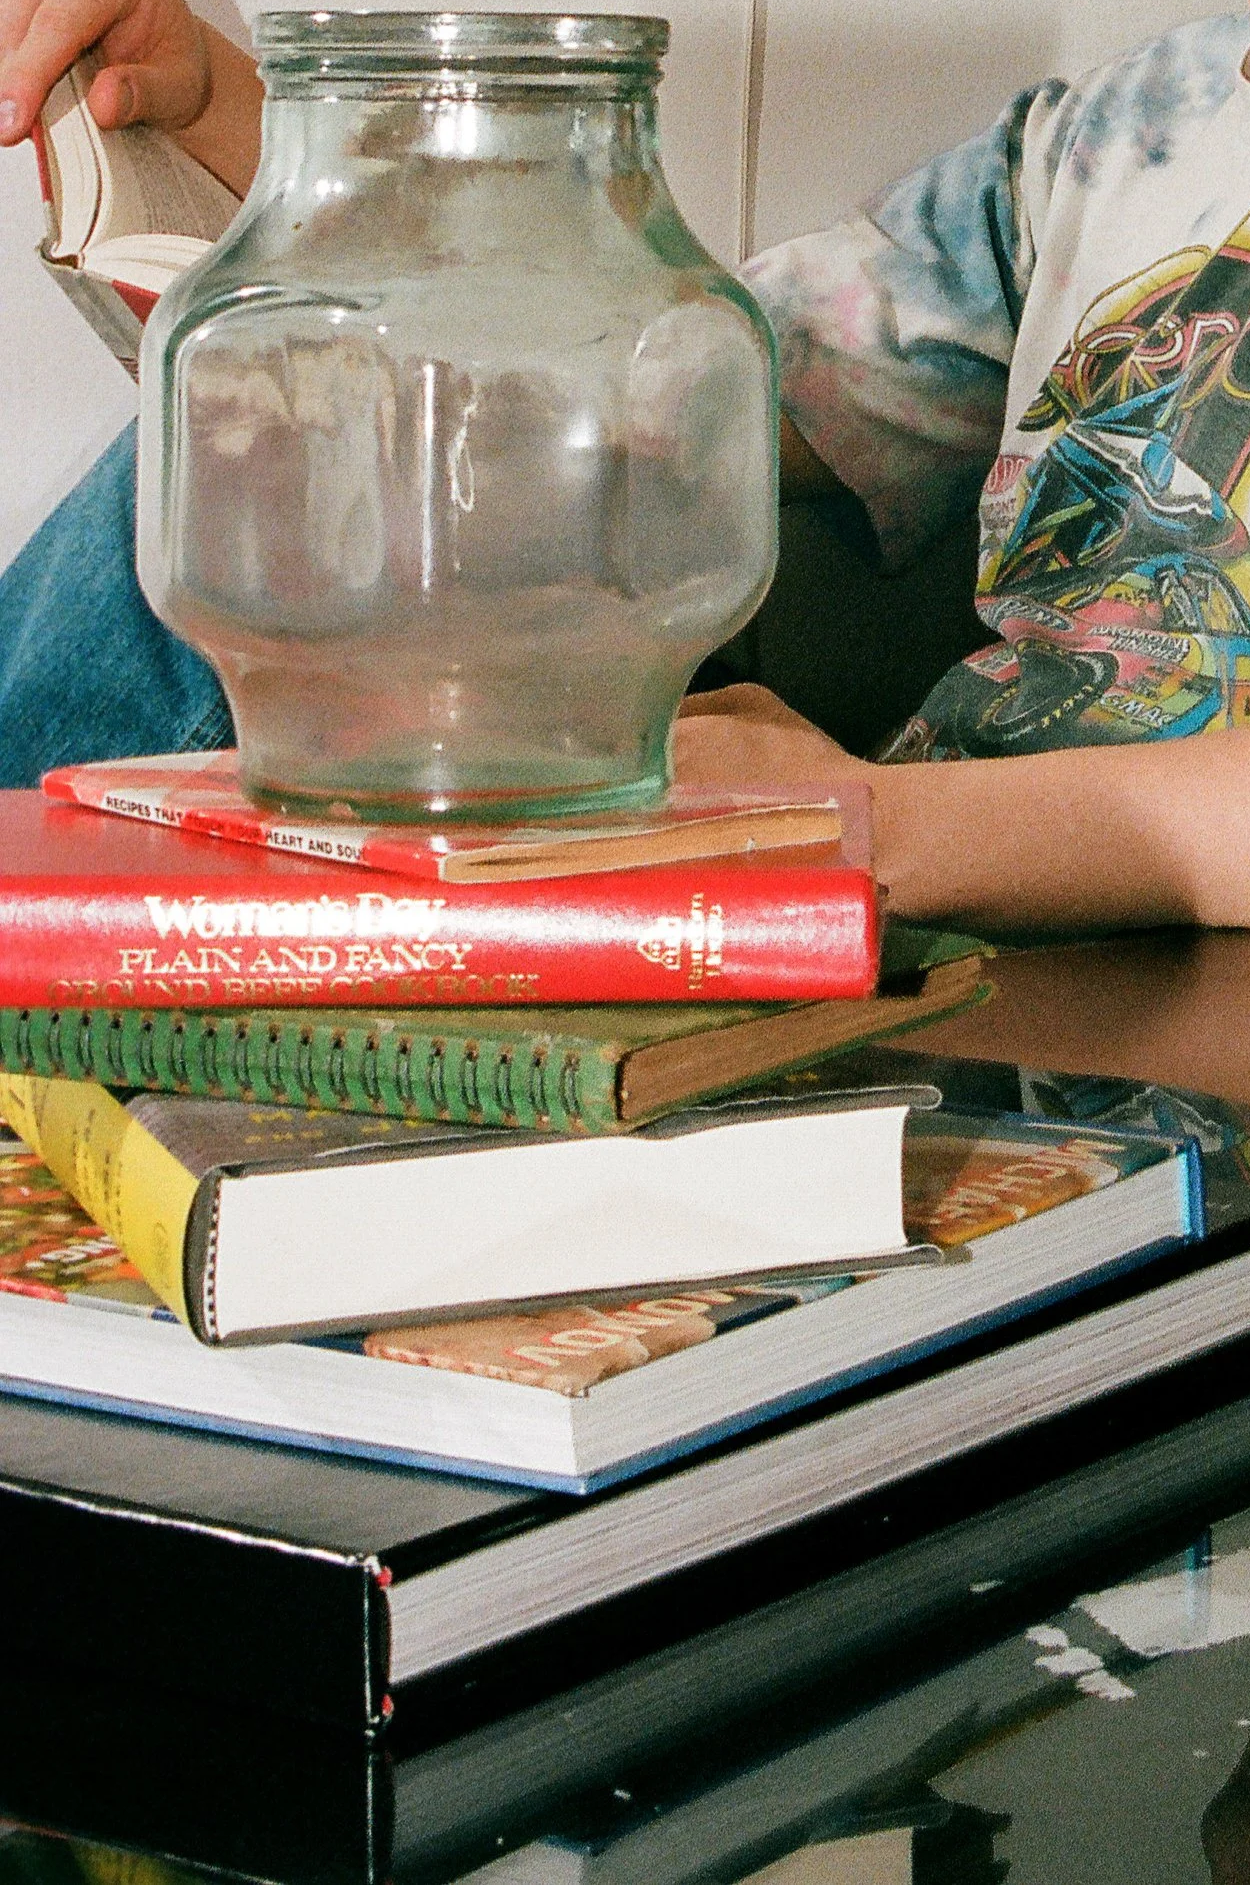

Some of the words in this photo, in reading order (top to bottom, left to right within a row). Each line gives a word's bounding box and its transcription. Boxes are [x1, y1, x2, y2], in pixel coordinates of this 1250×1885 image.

[1086, 625, 1191, 653] AUTOMOTIVE
[105, 795, 152, 818] RECIPES
[154, 806, 184, 824] THAT
[265, 830, 303, 849] HEART
[308, 839, 333, 855] AND
[144, 894, 350, 941] Woman's
[354, 892, 446, 941] Day
[118, 947, 242, 975] PLAIN
[248, 945, 338, 973] AND
[345, 942, 473, 972] FANCY
[44, 978, 212, 1004] GROUND
[222, 976, 324, 1001] BEEF
[329, 973, 541, 1000] COOKBOOK
